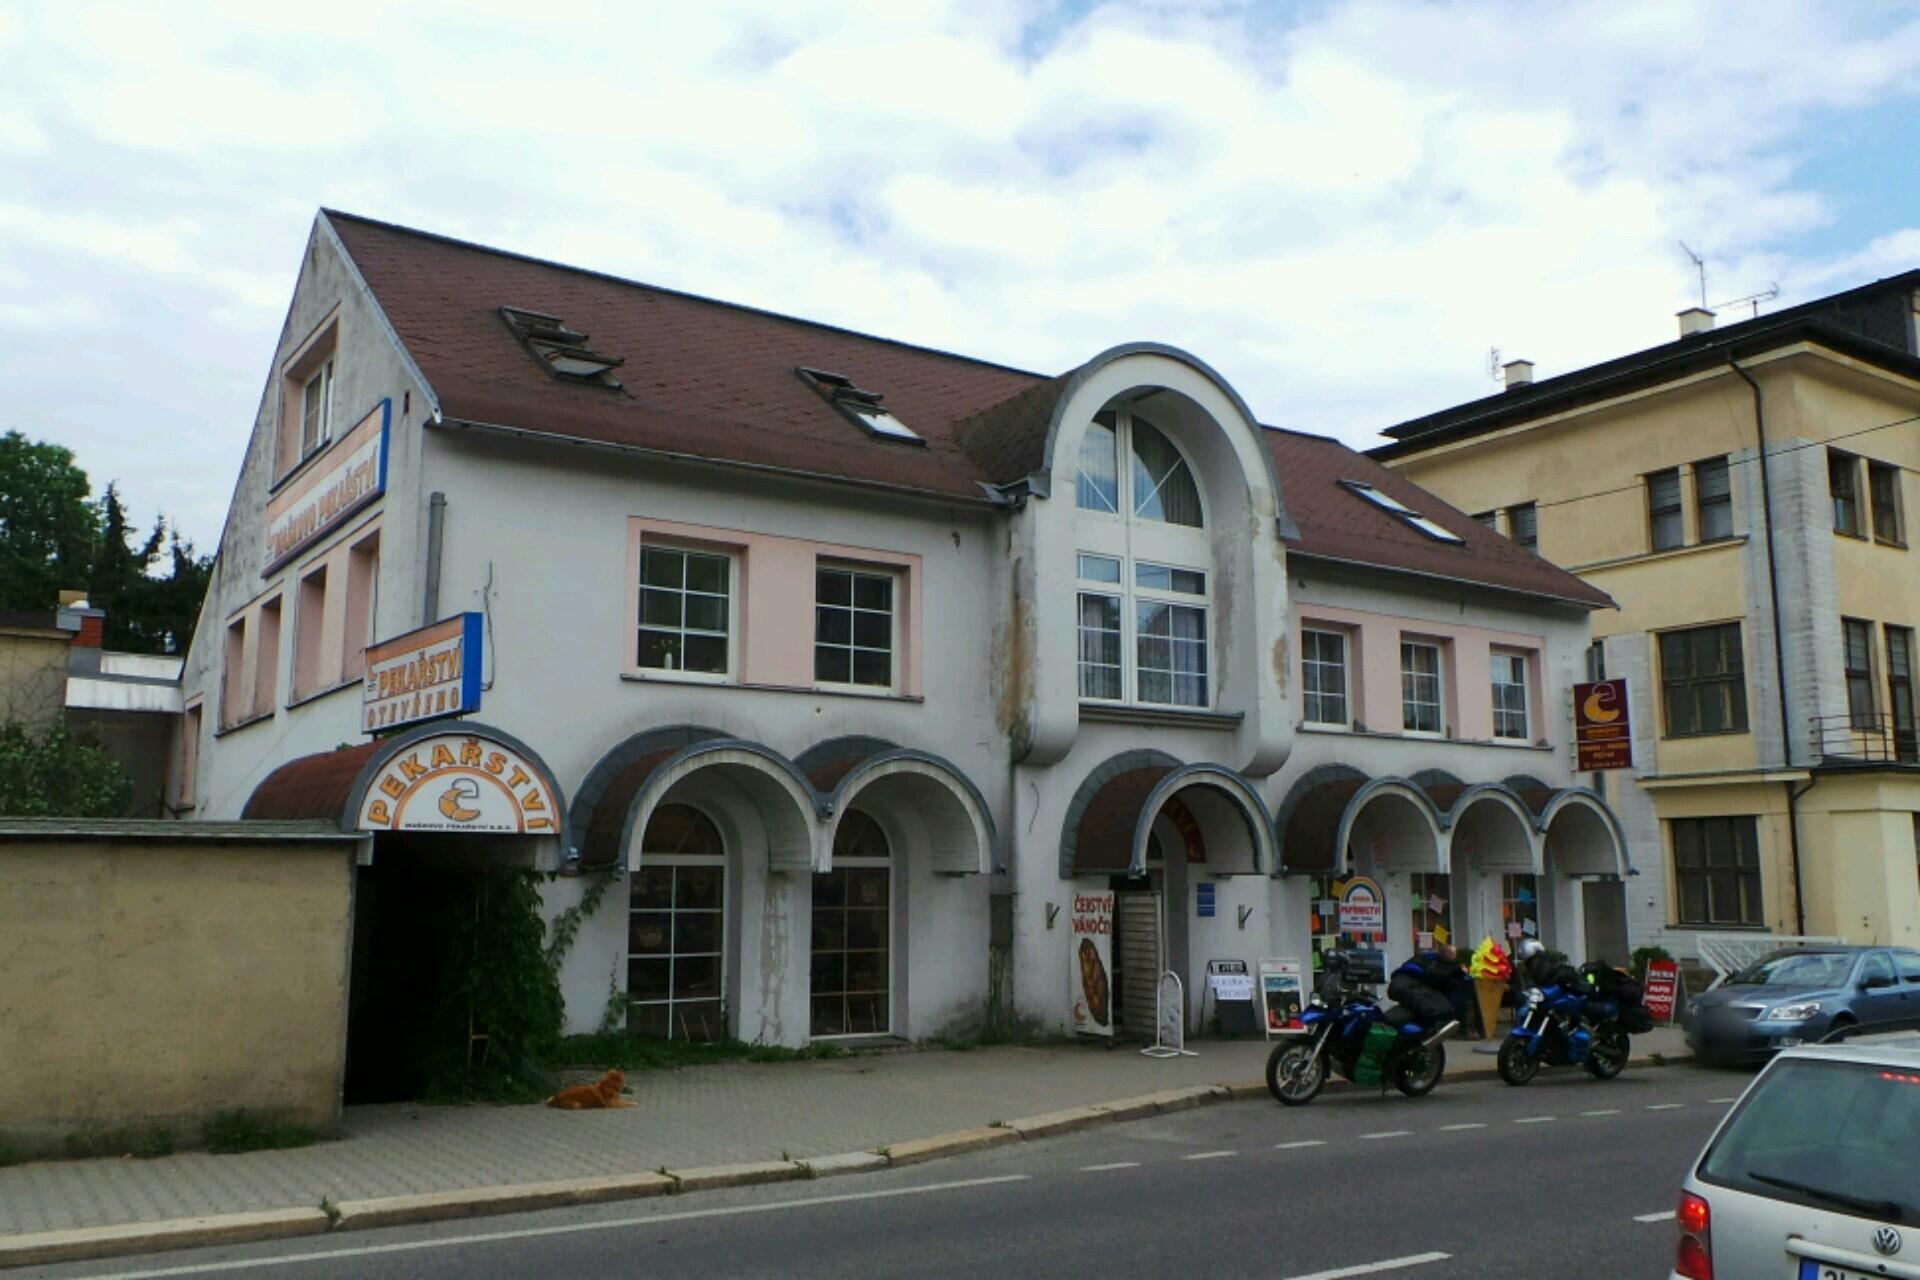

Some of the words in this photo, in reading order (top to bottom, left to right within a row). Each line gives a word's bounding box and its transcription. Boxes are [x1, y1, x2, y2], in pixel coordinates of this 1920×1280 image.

[378, 638, 464, 700] PEKAŘSTVÍ
[367, 690, 460, 729] OTEVŘENO
[367, 738, 555, 831] PEKAŘSTVÍ
